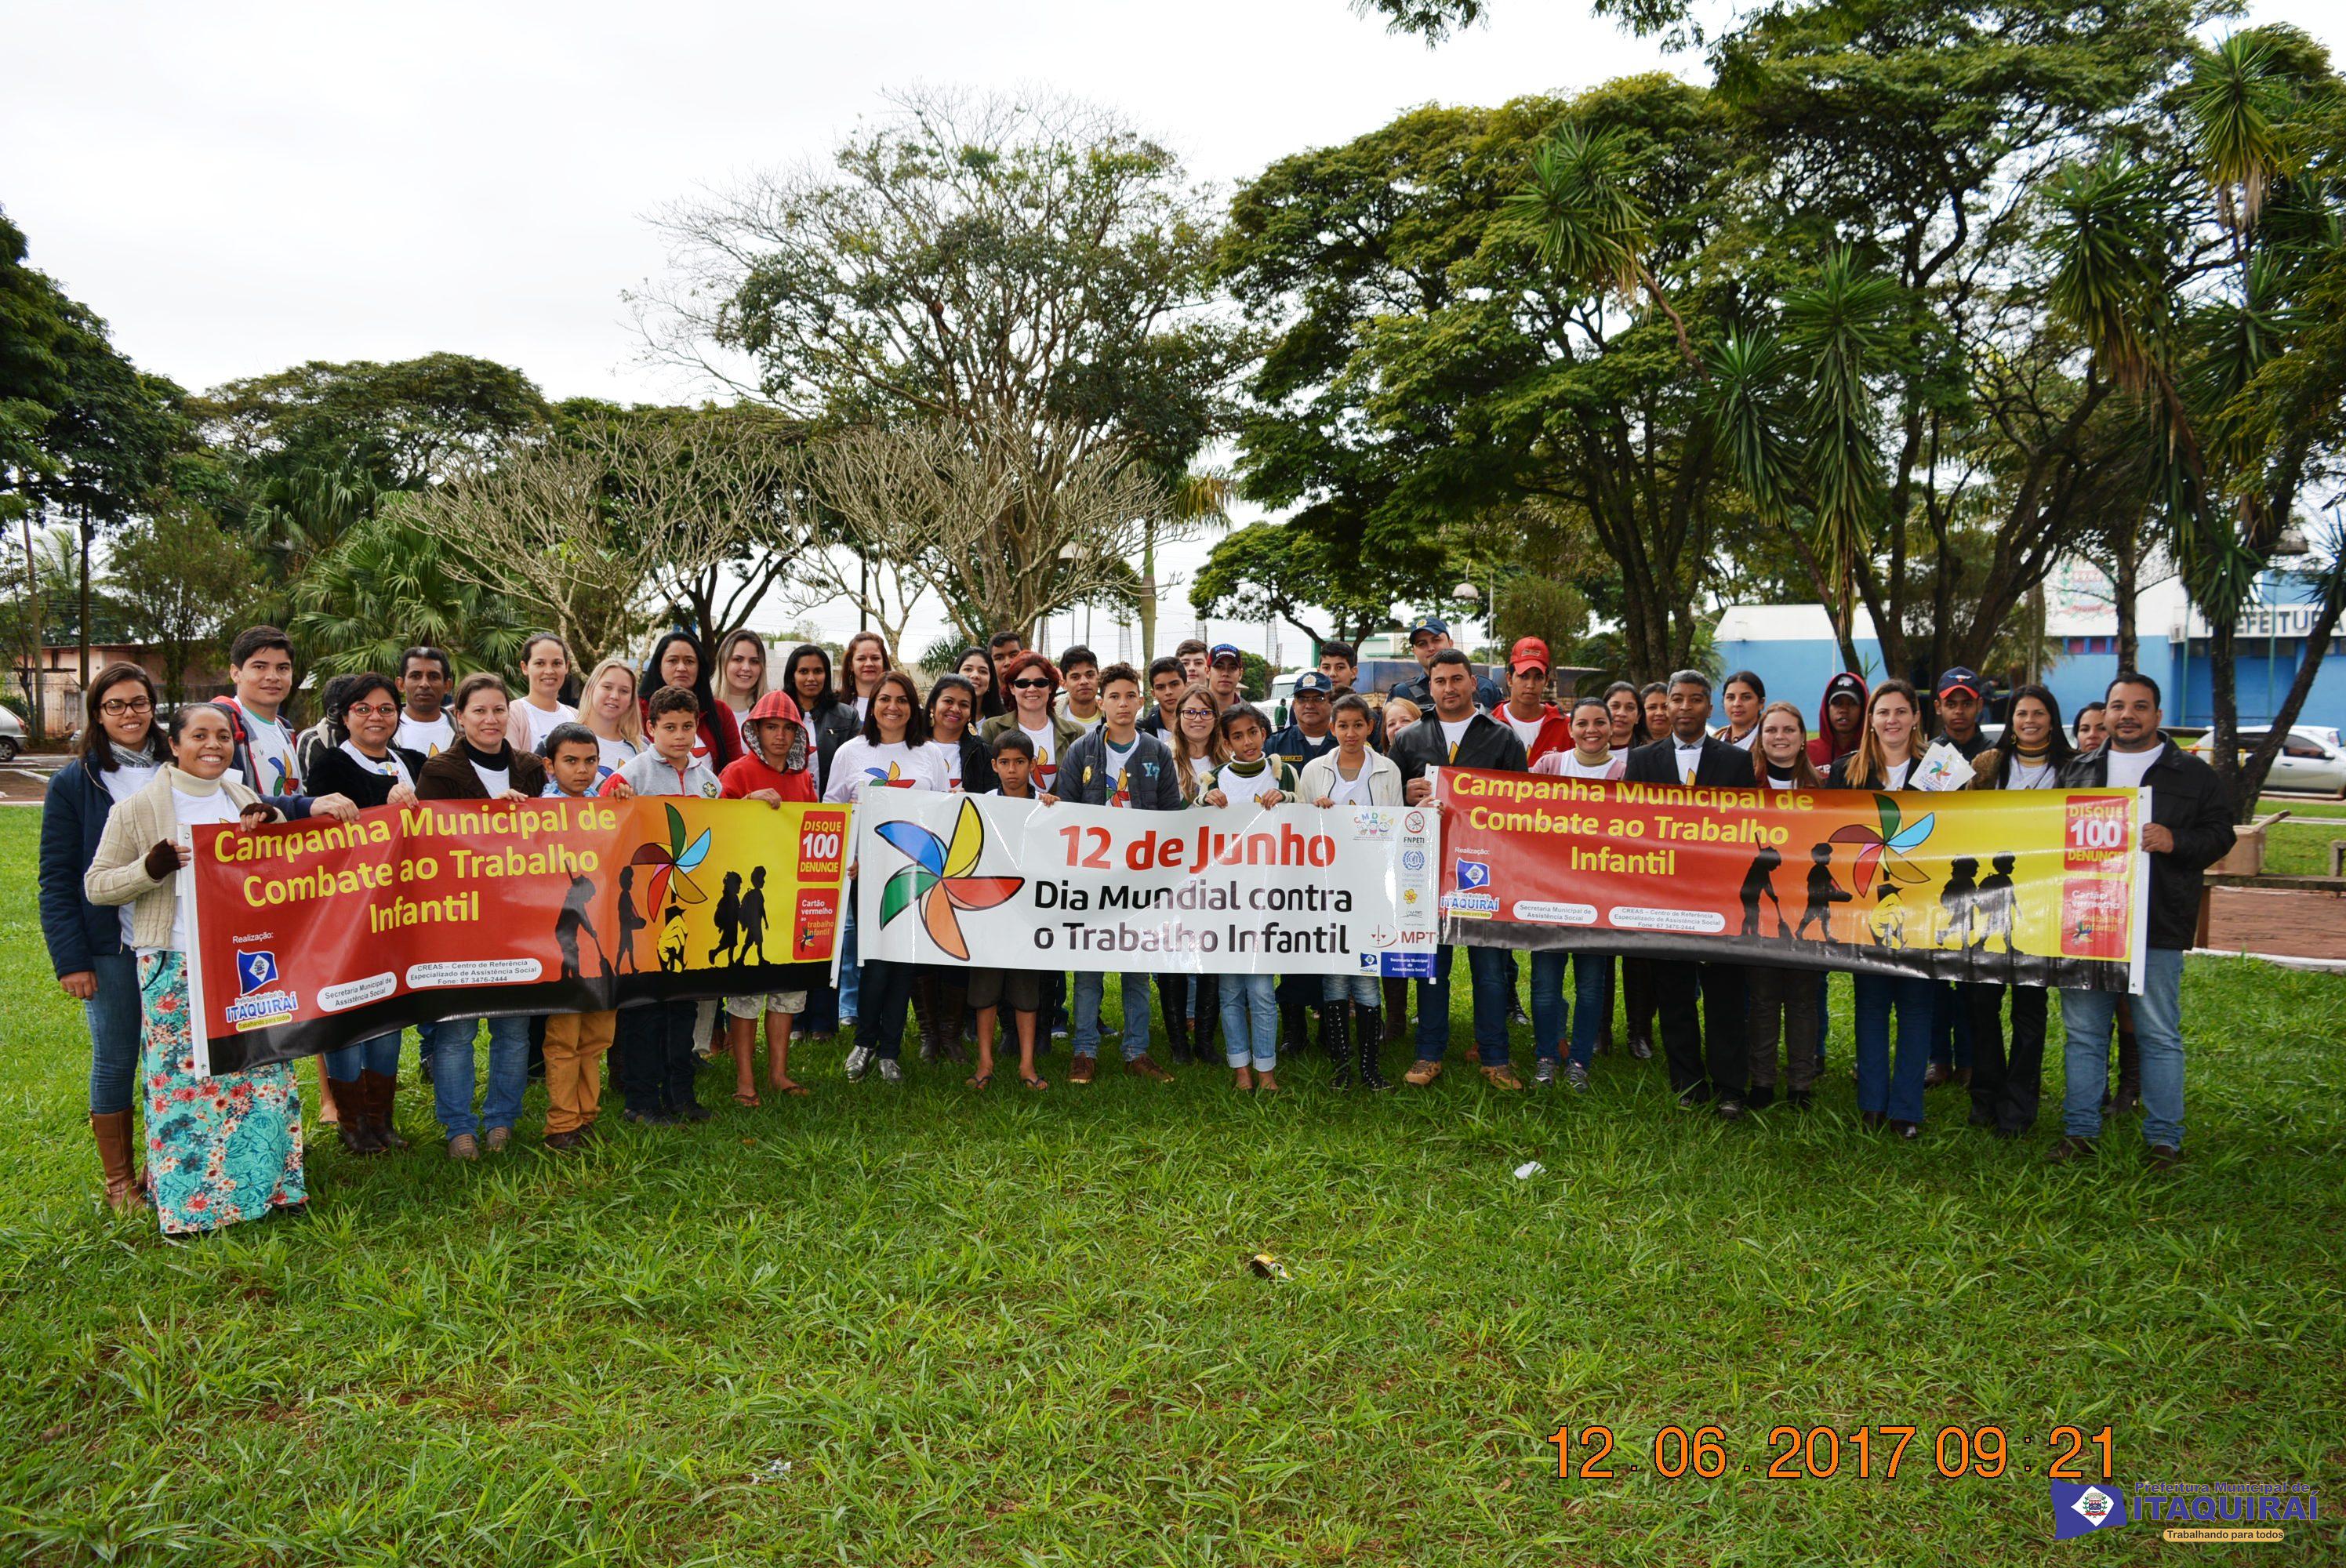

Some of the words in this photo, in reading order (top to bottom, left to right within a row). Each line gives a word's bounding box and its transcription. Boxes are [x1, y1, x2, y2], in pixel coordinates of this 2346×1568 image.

[1453, 773, 1605, 803] Campanha
[1615, 782, 1765, 813] Municipal
[1775, 790, 1814, 811] de
[2070, 806, 2123, 819] DISQUE
[214, 819, 390, 863] Campanha
[400, 802, 568, 839] Municipal
[579, 802, 617, 831] de
[804, 821, 841, 833] DISQUE
[1470, 806, 1599, 835] Combate
[1607, 818, 1644, 837] ao
[1655, 815, 1789, 845] Trabalho
[2070, 819, 2122, 848] 100
[802, 833, 839, 858] 100
[1059, 824, 1112, 870] 12
[1125, 828, 1185, 872] de
[1189, 823, 1336, 874] Junho
[800, 862, 838, 873] DENUNCIE
[1571, 847, 1676, 876] Infantil
[243, 863, 393, 907] Combate
[400, 858, 438, 881] ao
[448, 844, 599, 879] Trabalho
[1033, 880, 1090, 911] Dia
[1098, 880, 1242, 911] Mundial
[1248, 883, 1353, 913] contra
[1441, 896, 1499, 911] ITAQUIRAÍ
[370, 891, 479, 933] Infantil
[801, 906, 833, 915] vermelho
[1520, 904, 1551, 913] Secretaria
[232, 931, 274, 944] Realização:
[807, 928, 830, 937] infantil
[1033, 927, 1054, 950] o
[1062, 921, 1218, 953] Trabalho
[1229, 921, 1351, 955] Infantil
[1401, 931, 1436, 945] MPT
[410, 971, 458, 981] Especializado
[325, 986, 358, 1000] Secretaria
[359, 978, 384, 991] Municipal
[335, 993, 369, 1007] Assistência
[369, 987, 386, 997] Social
[227, 993, 297, 1022] ITAQUIRAÍ
